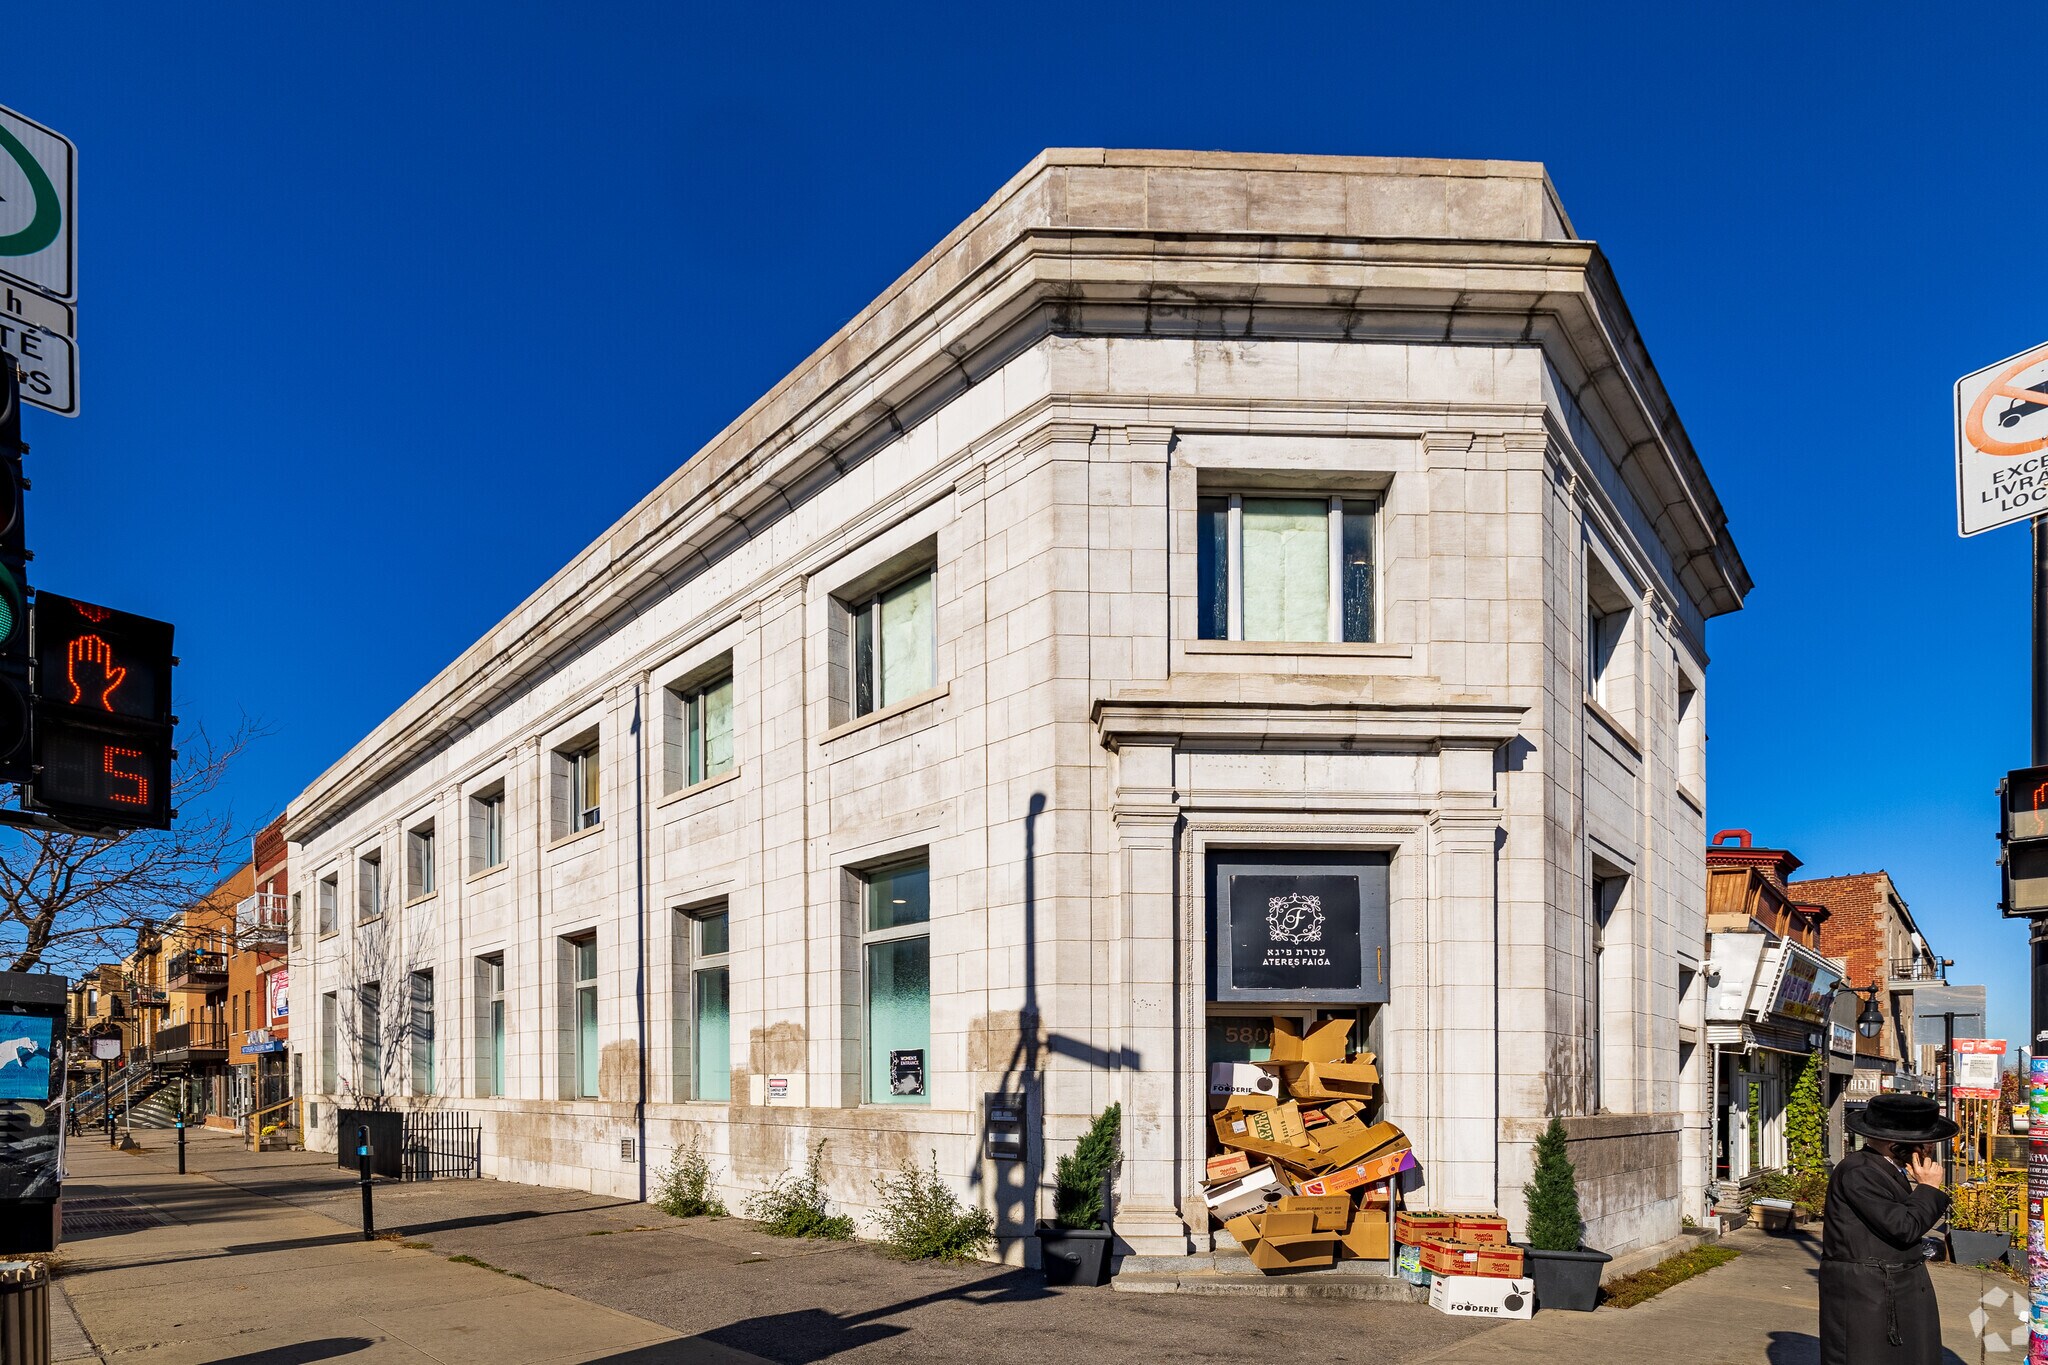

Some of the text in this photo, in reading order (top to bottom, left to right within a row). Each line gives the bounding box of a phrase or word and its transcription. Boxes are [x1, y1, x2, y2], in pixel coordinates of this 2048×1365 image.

[104, 745, 148, 805] 5
[1262, 958, 1331, 966] ATERES FAIGA
[1451, 1303, 1499, 1313] FOODERIE
